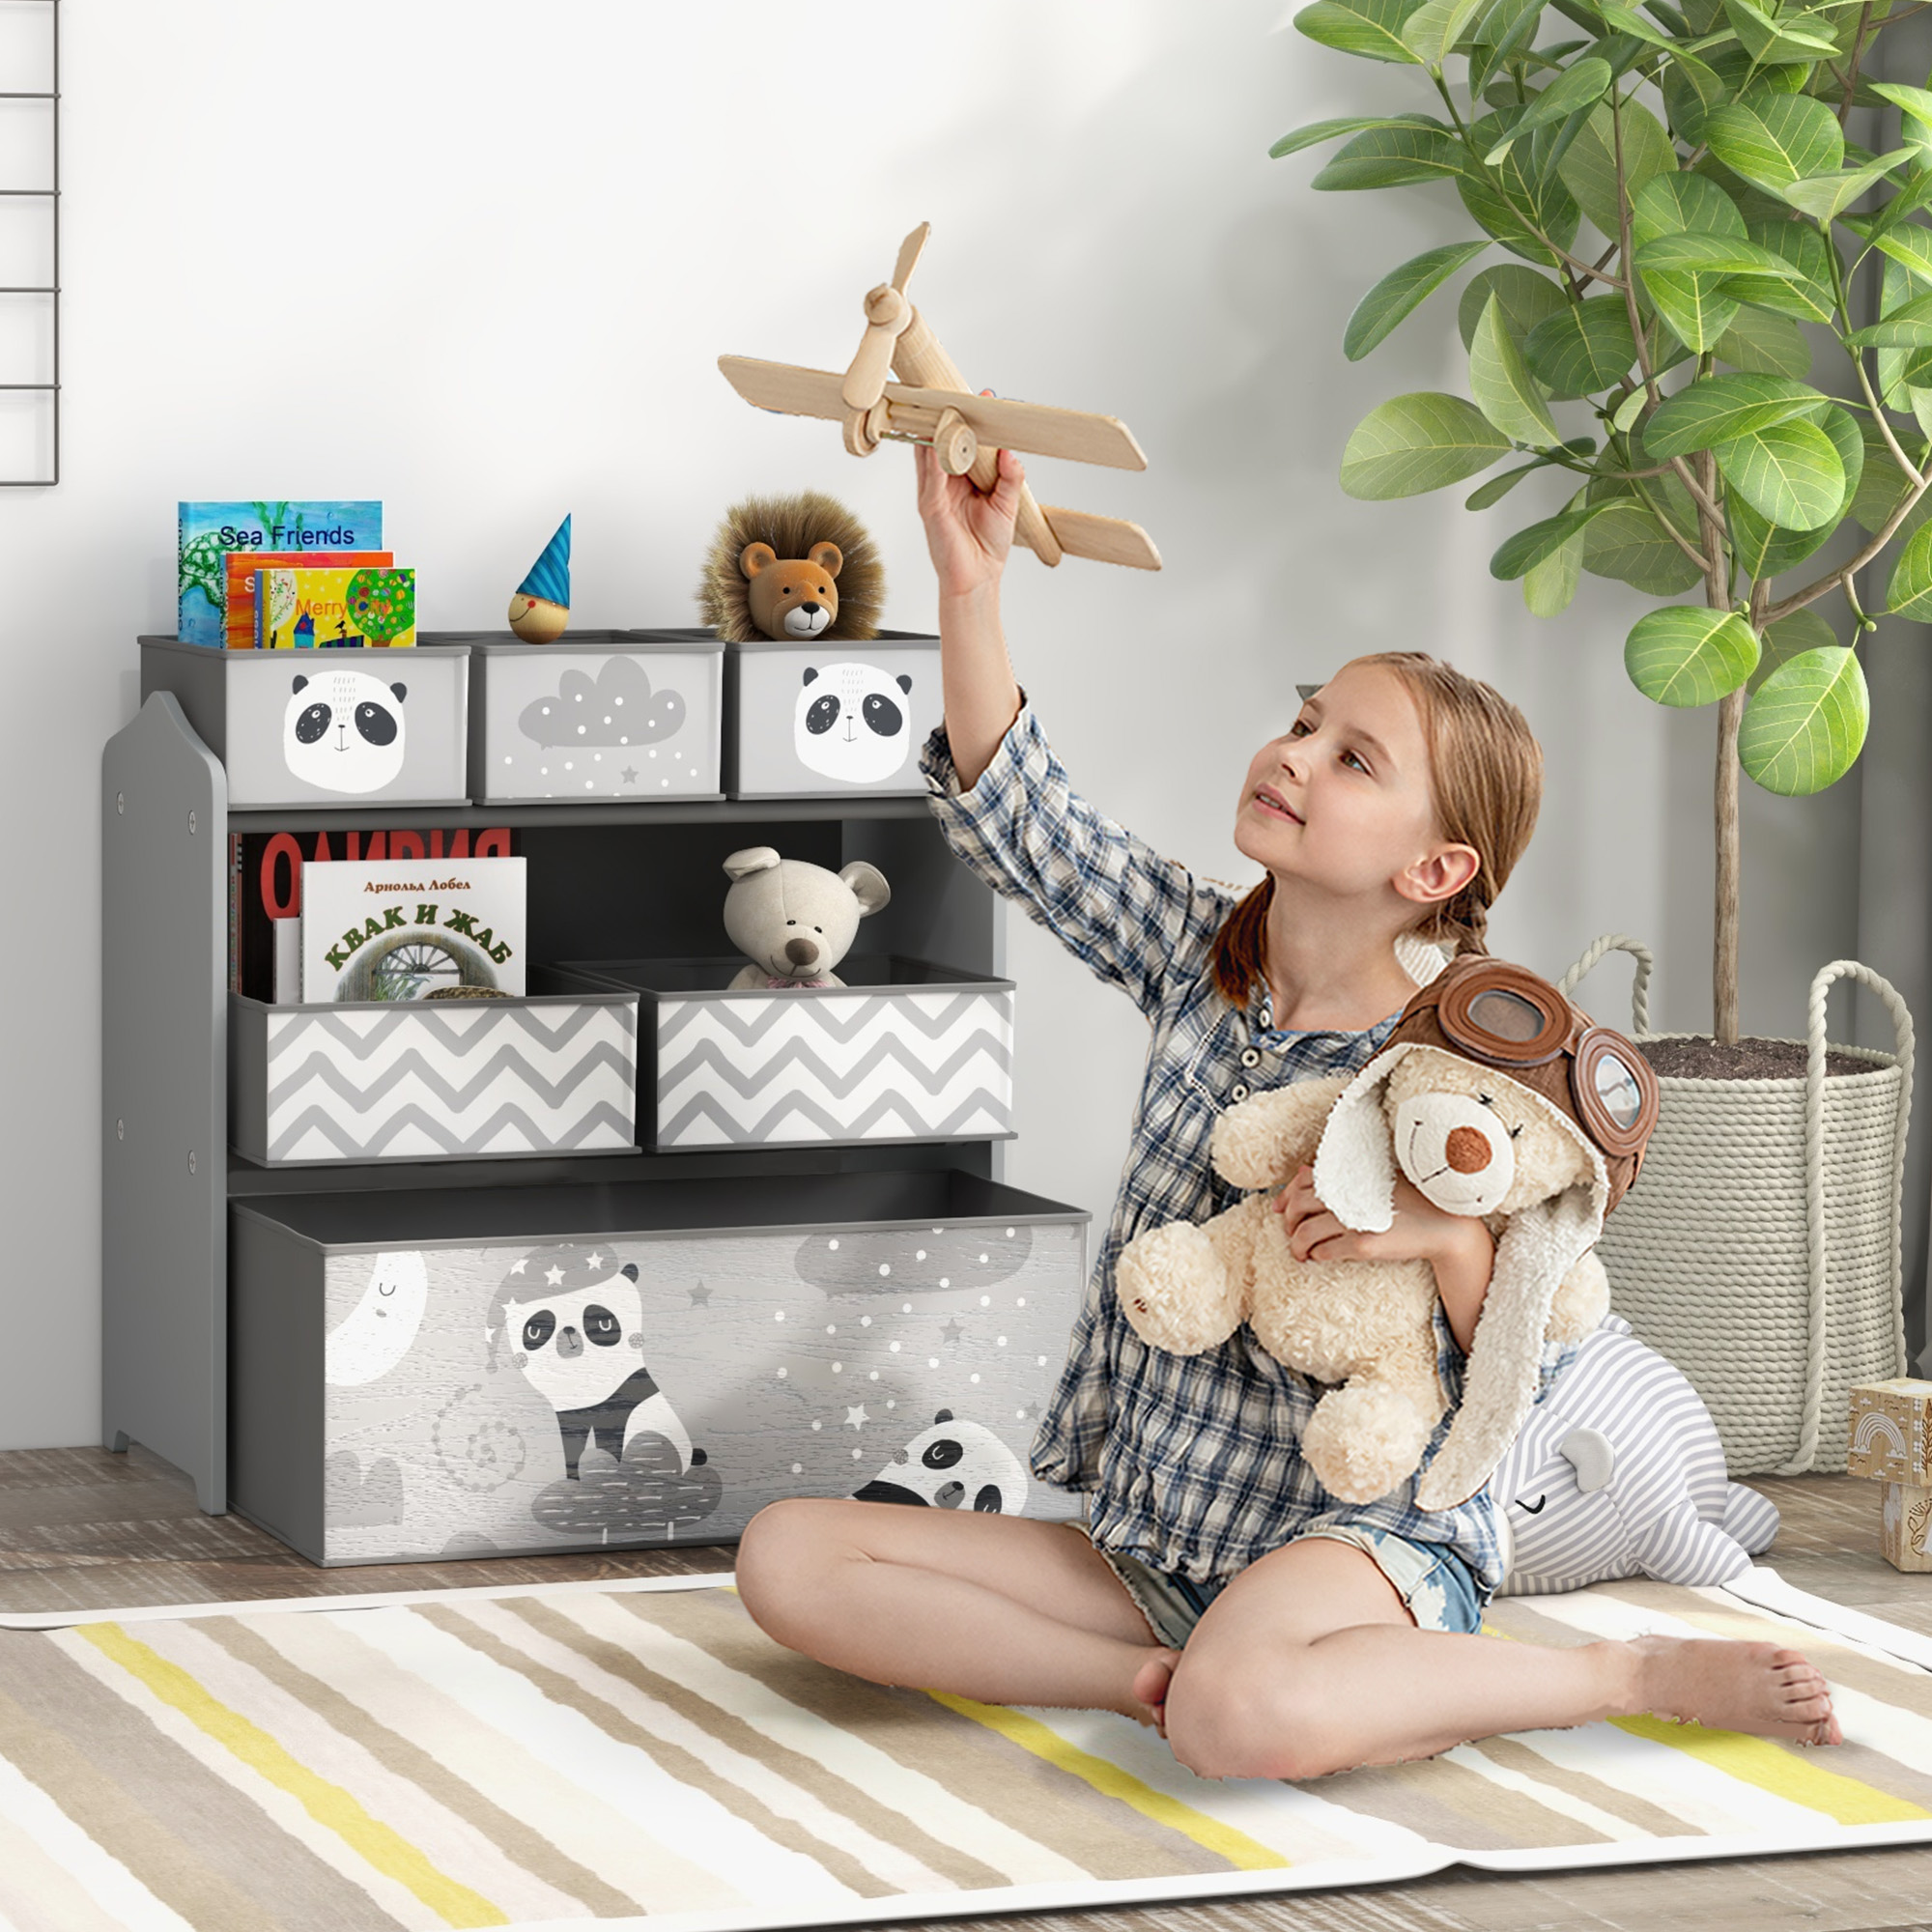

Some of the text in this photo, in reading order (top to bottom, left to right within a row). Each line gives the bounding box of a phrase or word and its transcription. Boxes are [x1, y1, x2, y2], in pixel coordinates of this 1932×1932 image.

[219, 526, 355, 546] Sea Friends
[295, 599, 348, 619] Merry
[363, 878, 471, 895] Арнольд Лобел
[324, 906, 408, 972] КВАК
[413, 903, 440, 924] И
[443, 909, 513, 965] ЖАБ
